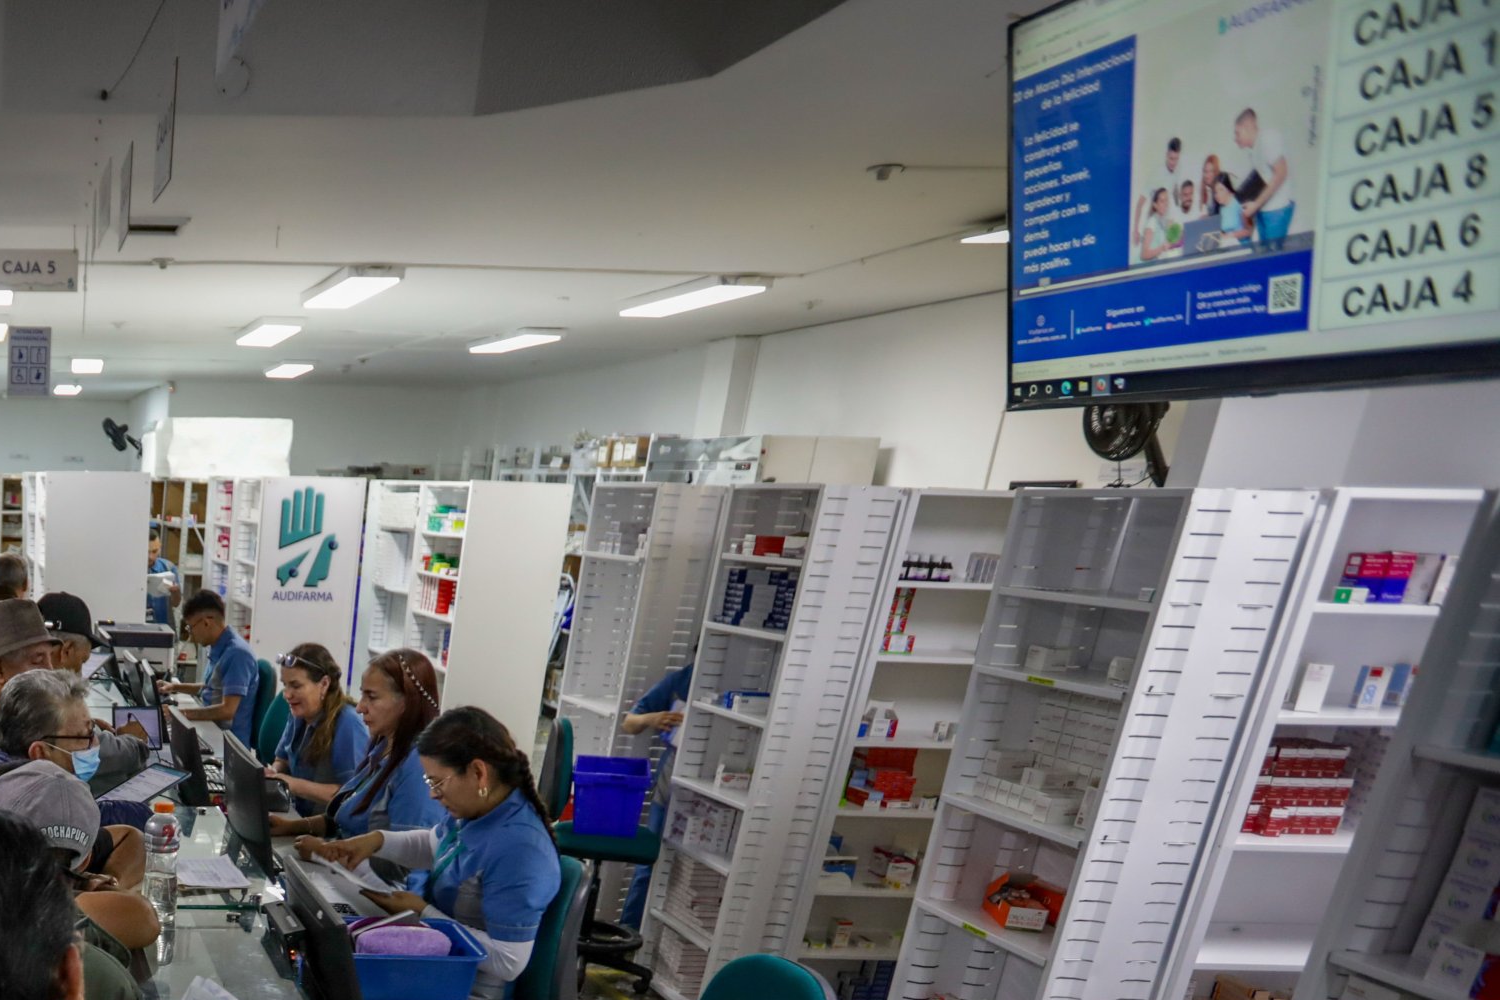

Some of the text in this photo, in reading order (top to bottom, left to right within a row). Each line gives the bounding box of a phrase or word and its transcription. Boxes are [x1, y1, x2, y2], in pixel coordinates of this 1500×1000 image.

[1359, 29, 1497, 100] CAJA 1
[1354, 102, 1459, 157] CAJA
[1471, 91, 1495, 130] 5
[1350, 153, 1488, 212] CAJA 8
[1346, 212, 1481, 265] CAJA 6
[2, 260, 56, 275] CAJA 5
[1342, 269, 1474, 317] CAJA 4
[271, 590, 334, 602] AUDIFARMA
